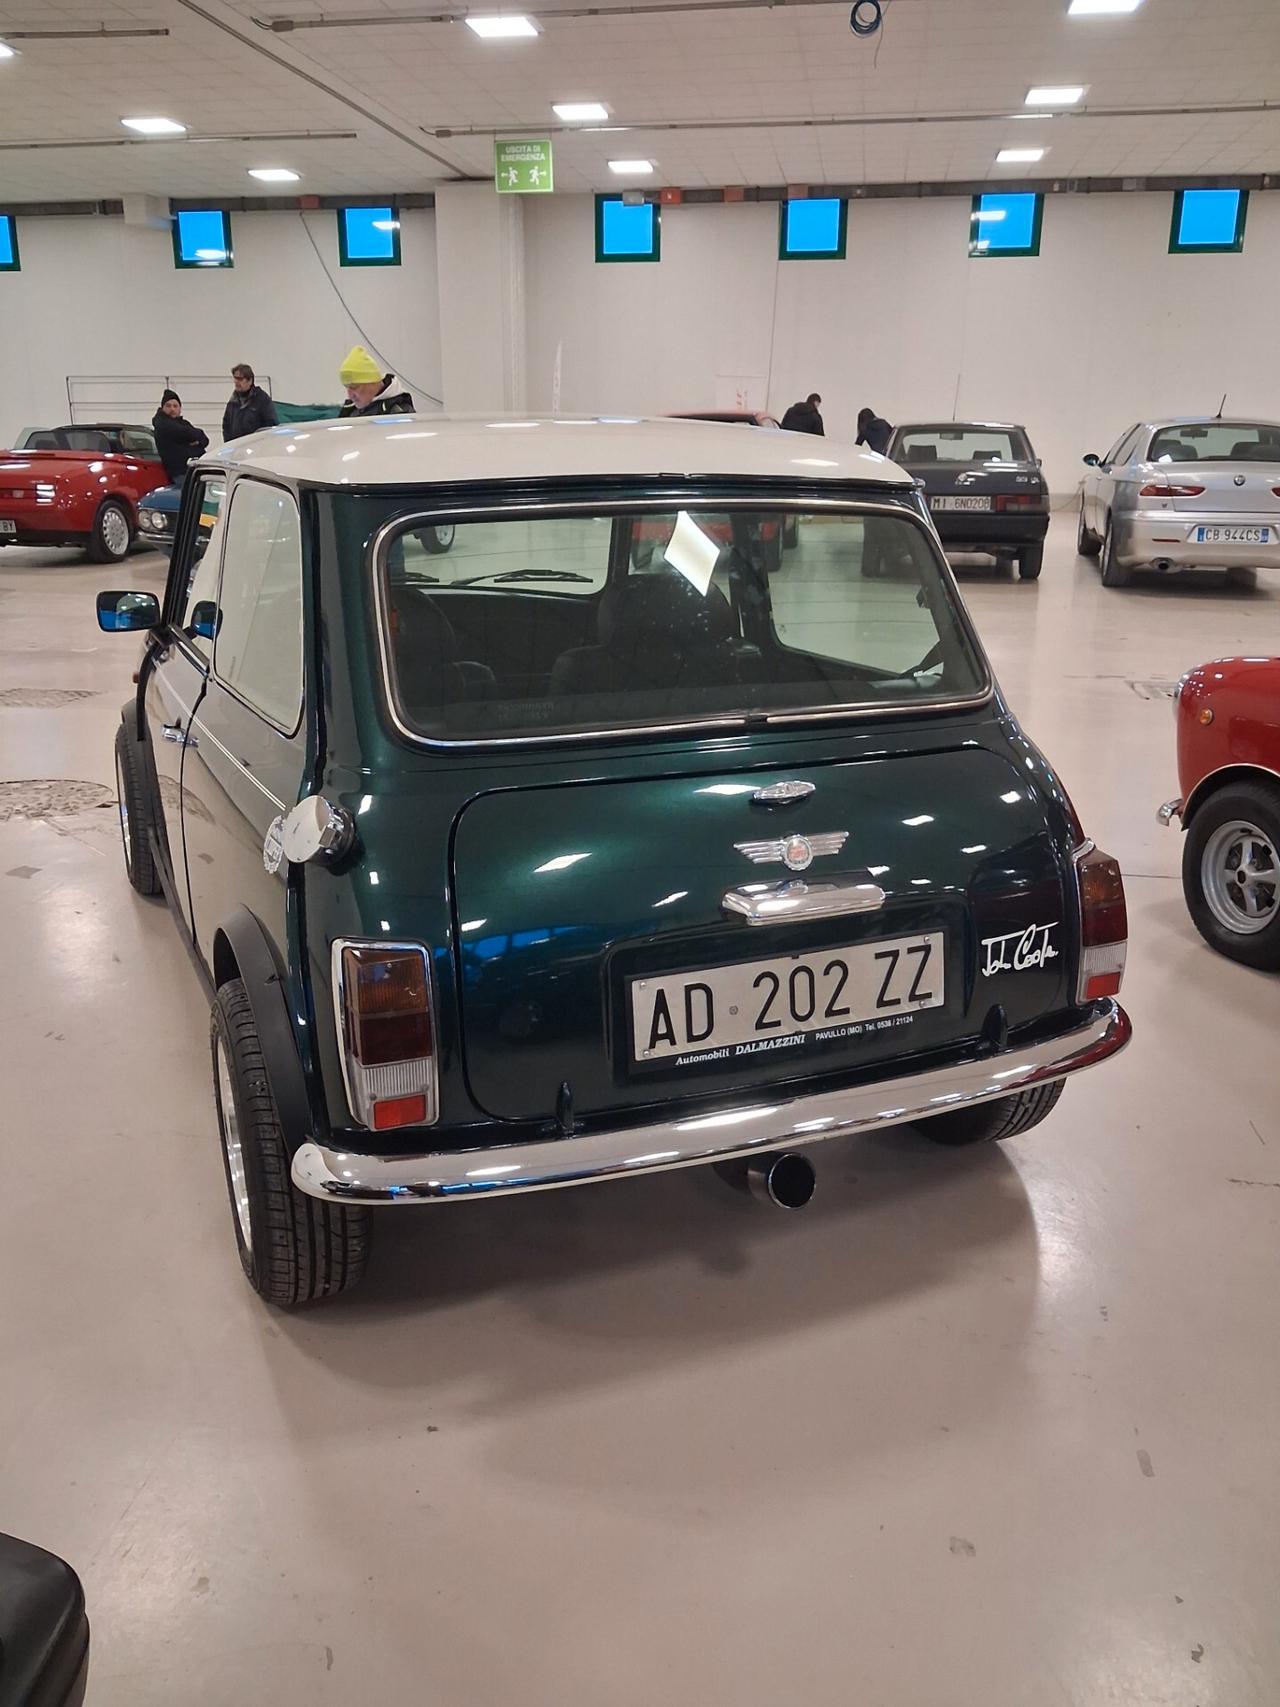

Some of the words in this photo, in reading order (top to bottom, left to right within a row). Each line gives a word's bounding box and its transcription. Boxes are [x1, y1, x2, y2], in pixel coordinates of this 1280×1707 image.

[505, 145, 532, 153] USCITA
[500, 153, 546, 161] EMERGENZA
[933, 495, 946, 509] MI
[1205, 529, 1220, 541] CB
[648, 982, 714, 1049] AD
[752, 959, 851, 1030] 202
[874, 944, 933, 1009] ZZ
[675, 1048, 730, 1066] Automobili
[735, 1034, 806, 1056] DALMAZZINI
[815, 1028, 847, 1041] PAVULLO
[847, 1025, 863, 1036] (MO)
